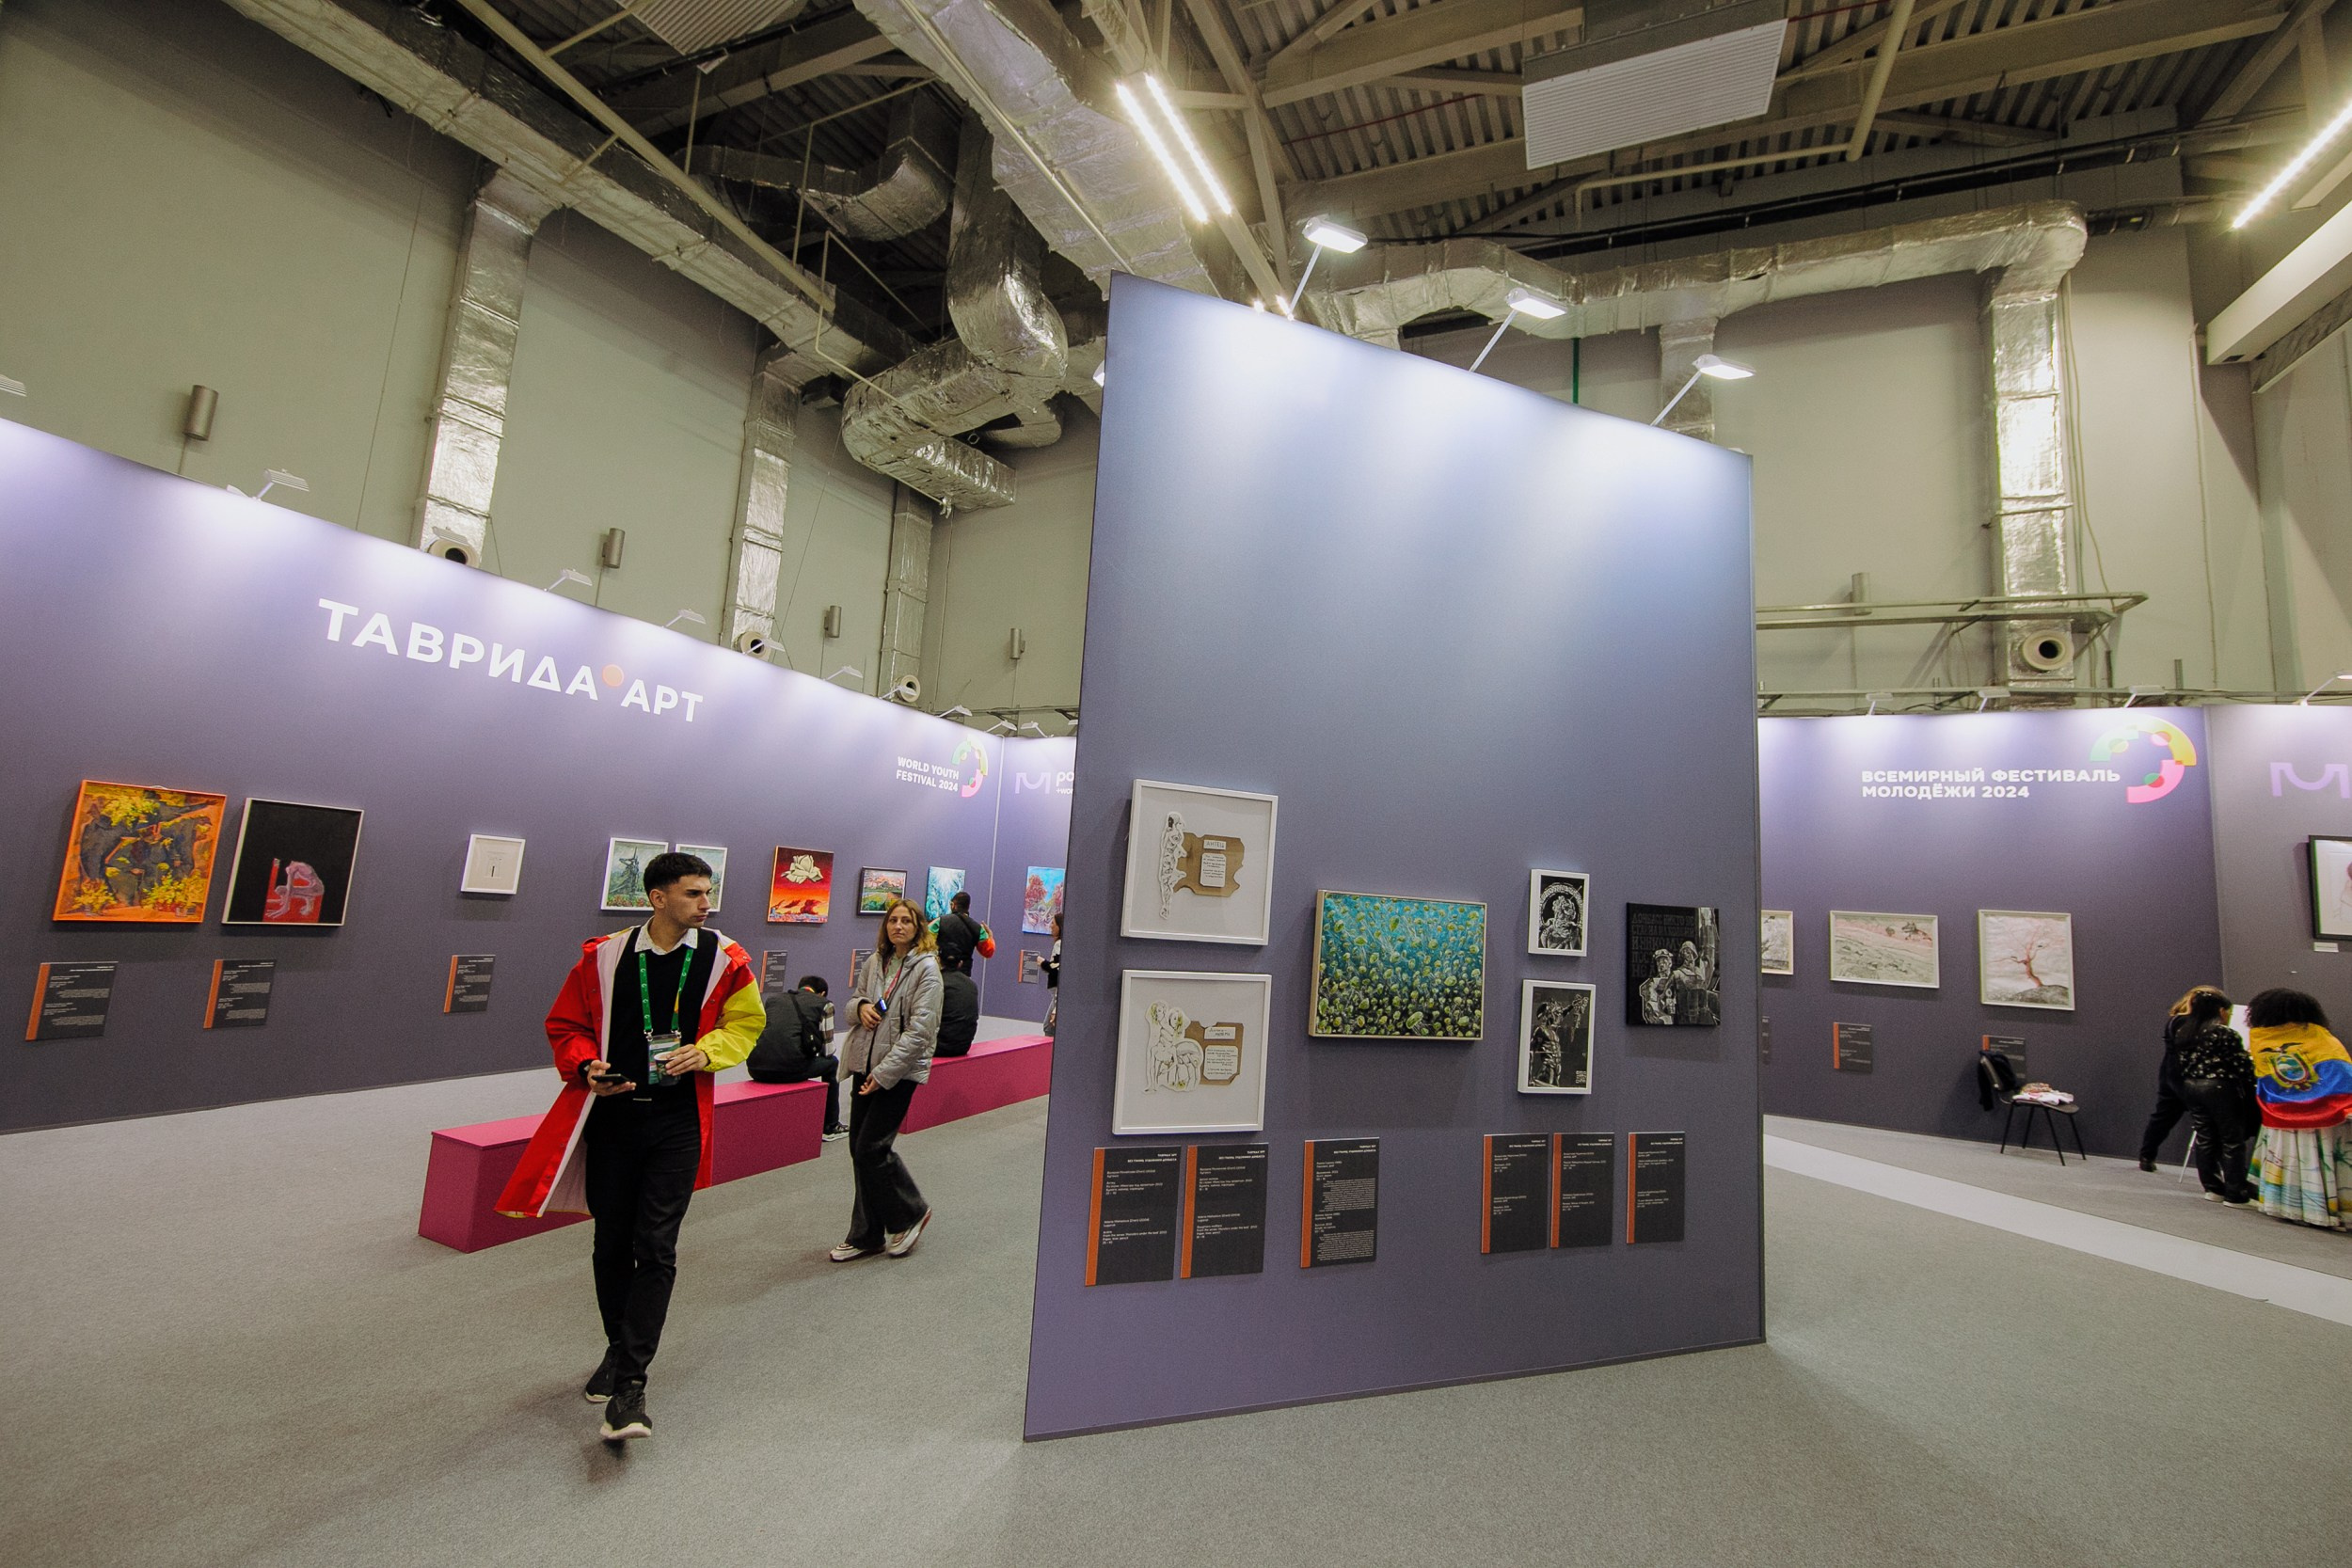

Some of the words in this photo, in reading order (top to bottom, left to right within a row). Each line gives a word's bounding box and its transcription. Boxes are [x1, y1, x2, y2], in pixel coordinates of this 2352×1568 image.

[318, 598, 598, 701] ТАВРИДА
[620, 679, 704, 722] АРТ
[898, 756, 930, 772] WORLD
[931, 764, 960, 780] YOUTH
[1862, 767, 1985, 783] ВСЕМИРНЫЙ
[1991, 768, 2121, 783] ФЕСТИВАЛЬ
[896, 769, 936, 787] FESTIVAL
[938, 779, 959, 792] 2024
[1862, 783, 1976, 800] МОЛОДЁЖИ
[1981, 785, 2029, 798] 2024
